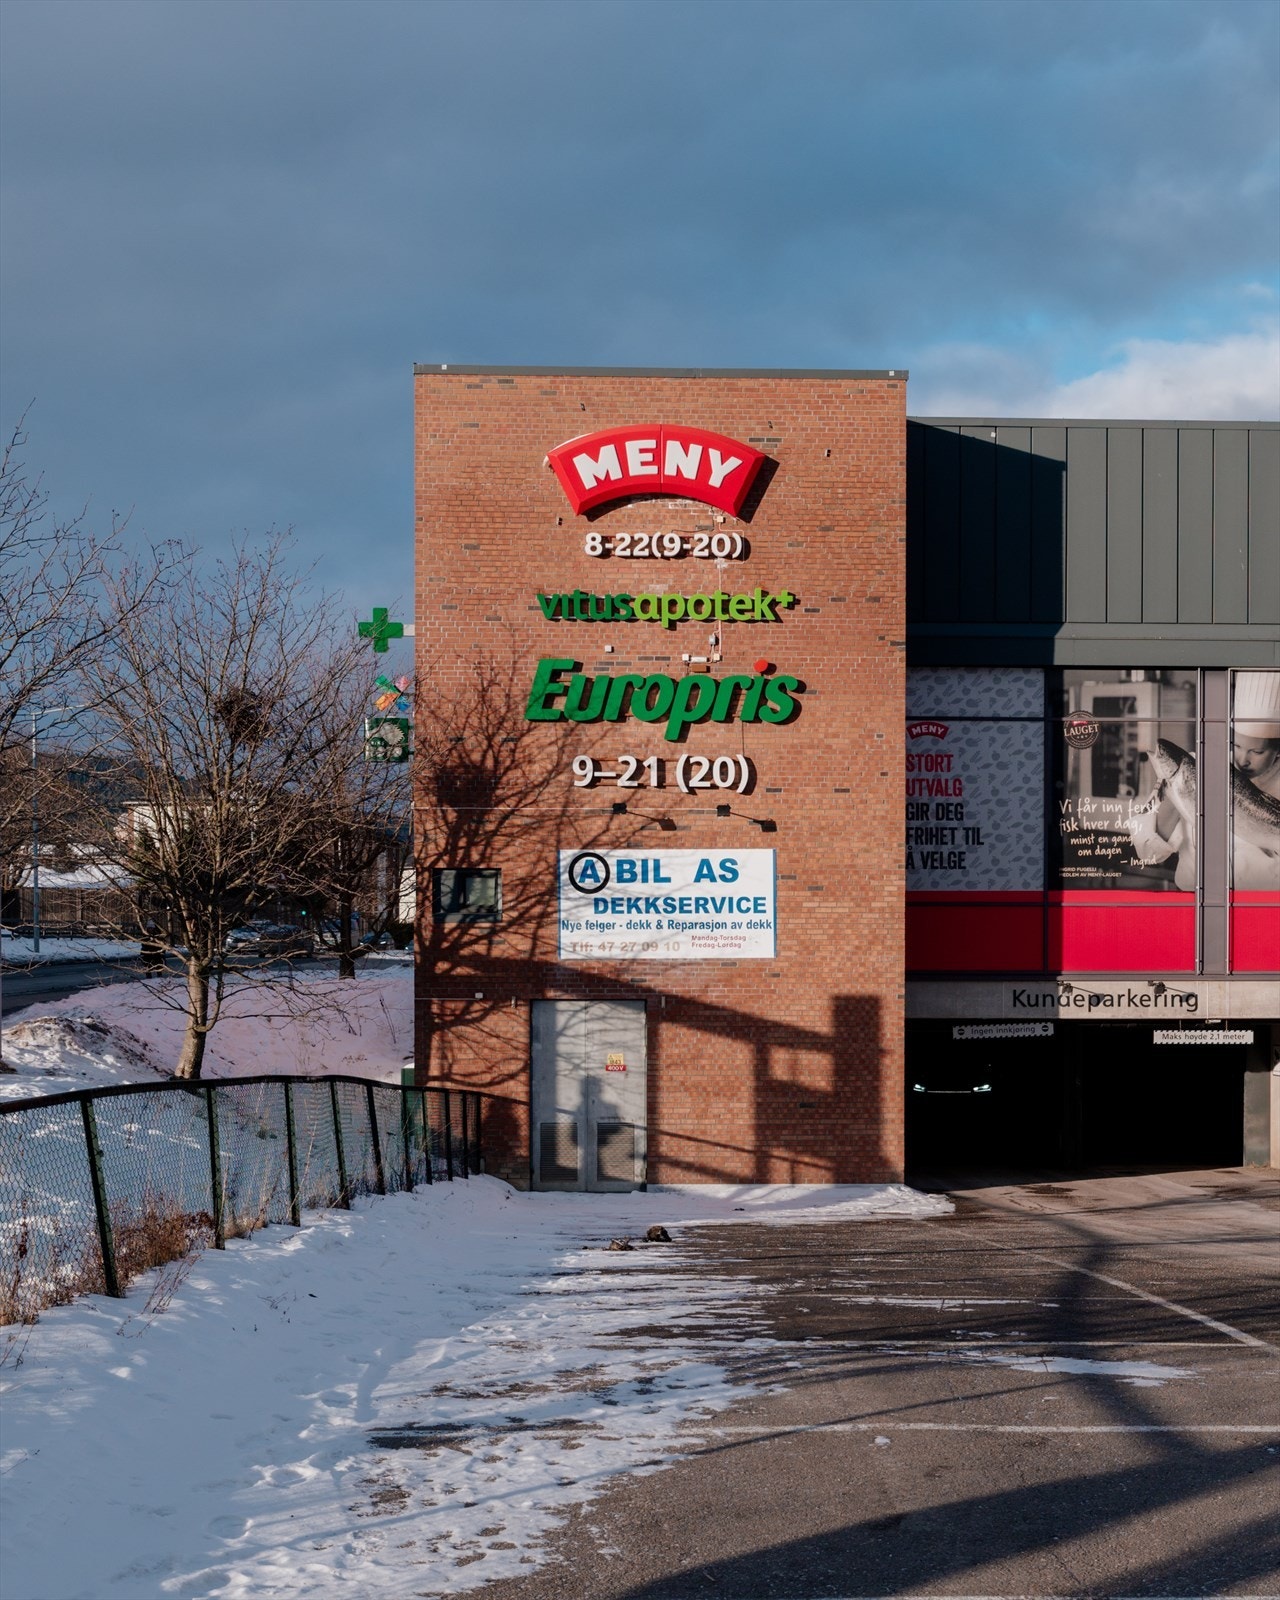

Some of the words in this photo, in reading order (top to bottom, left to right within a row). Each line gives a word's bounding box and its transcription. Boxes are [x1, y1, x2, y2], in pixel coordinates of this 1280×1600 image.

[572, 439, 743, 490] MENY
[584, 532, 742, 557] 8-22(9-20)
[524, 658, 798, 741] Europris
[911, 724, 945, 736] MENY
[1063, 723, 1100, 737] LAUGET
[906, 754, 954, 773] STORT
[676, 754, 749, 793] (20)
[906, 778, 963, 797] UTVALG
[906, 803, 930, 821] GIR
[935, 803, 964, 821] DEG
[1059, 798, 1072, 814] Vi
[1077, 797, 1097, 819] får
[1102, 799, 1123, 813] inn
[1128, 798, 1160, 819] fersk
[1060, 816, 1079, 837] fisk
[1083, 816, 1110, 831] hver
[1114, 815, 1143, 835] dag,
[906, 827, 958, 846] FRIHET
[963, 827, 985, 846] TIL
[1070, 833, 1095, 845] minst
[1098, 836, 1109, 844] en
[1111, 835, 1134, 847] gang
[906, 845, 915, 870] Å
[920, 851, 967, 870] VELGE
[1077, 848, 1092, 856] om
[1094, 845, 1122, 859] dagen
[616, 859, 672, 884] BIL
[693, 858, 740, 884] AS
[1130, 855, 1158, 870] Ingrid
[593, 896, 767, 915] DEKKSERVICE
[561, 920, 582, 933] Nye
[585, 920, 616, 933] felger
[626, 920, 652, 930] dekk
[655, 920, 664, 930] &
[667, 919, 728, 932] Reparasjon
[731, 921, 743, 930] av
[746, 919, 773, 930] dekk
[598, 942, 615, 952] 47
[620, 942, 637, 952] 27
[641, 942, 659, 952] 09
[664, 941, 681, 952] 10
[691, 935, 747, 943] Mandag-Torsdag
[1012, 988, 1199, 1012] Kundeparkering
[971, 1028, 993, 1036] Ingen
[996, 1026, 1036, 1035] innkjøring
[1185, 1033, 1207, 1041] høyde
[1209, 1033, 1220, 1041] 2,1
